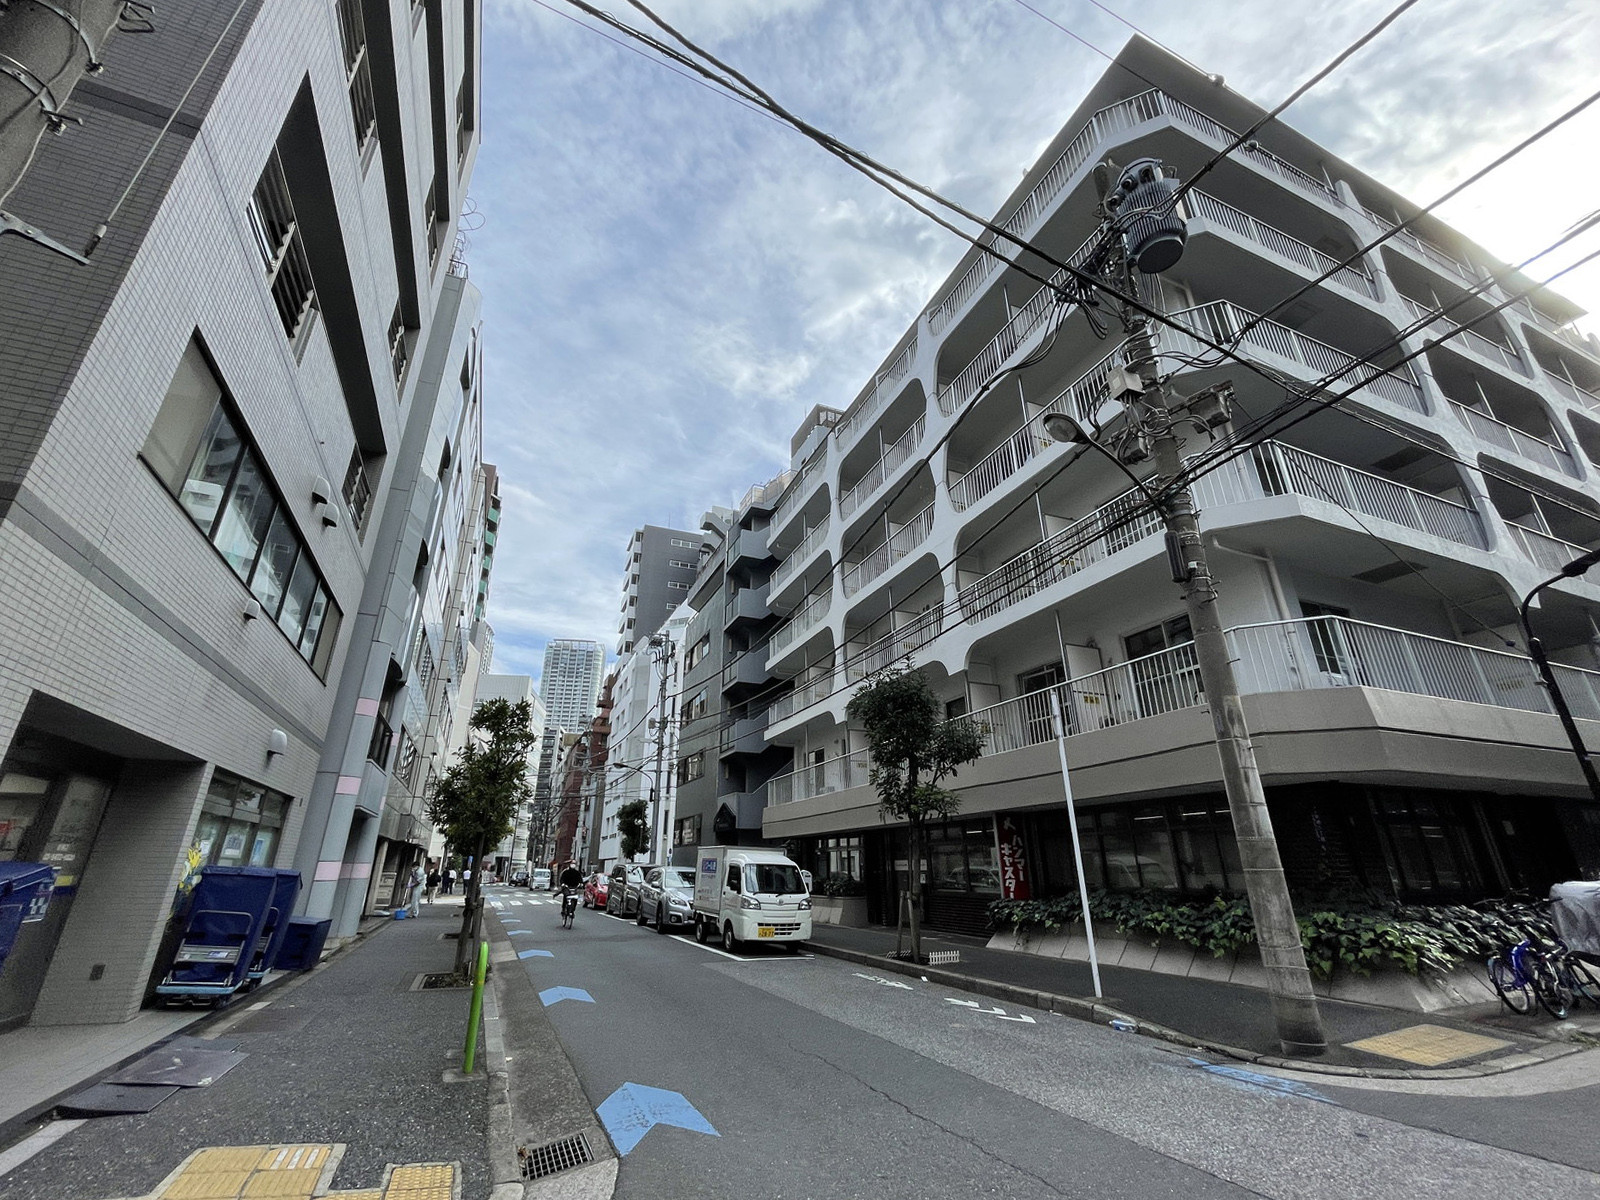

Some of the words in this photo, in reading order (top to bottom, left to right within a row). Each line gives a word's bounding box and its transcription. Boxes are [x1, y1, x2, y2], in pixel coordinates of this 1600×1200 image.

[1001, 843, 1016, 899] キャスター
[1012, 835, 1025, 881] ハンマー
